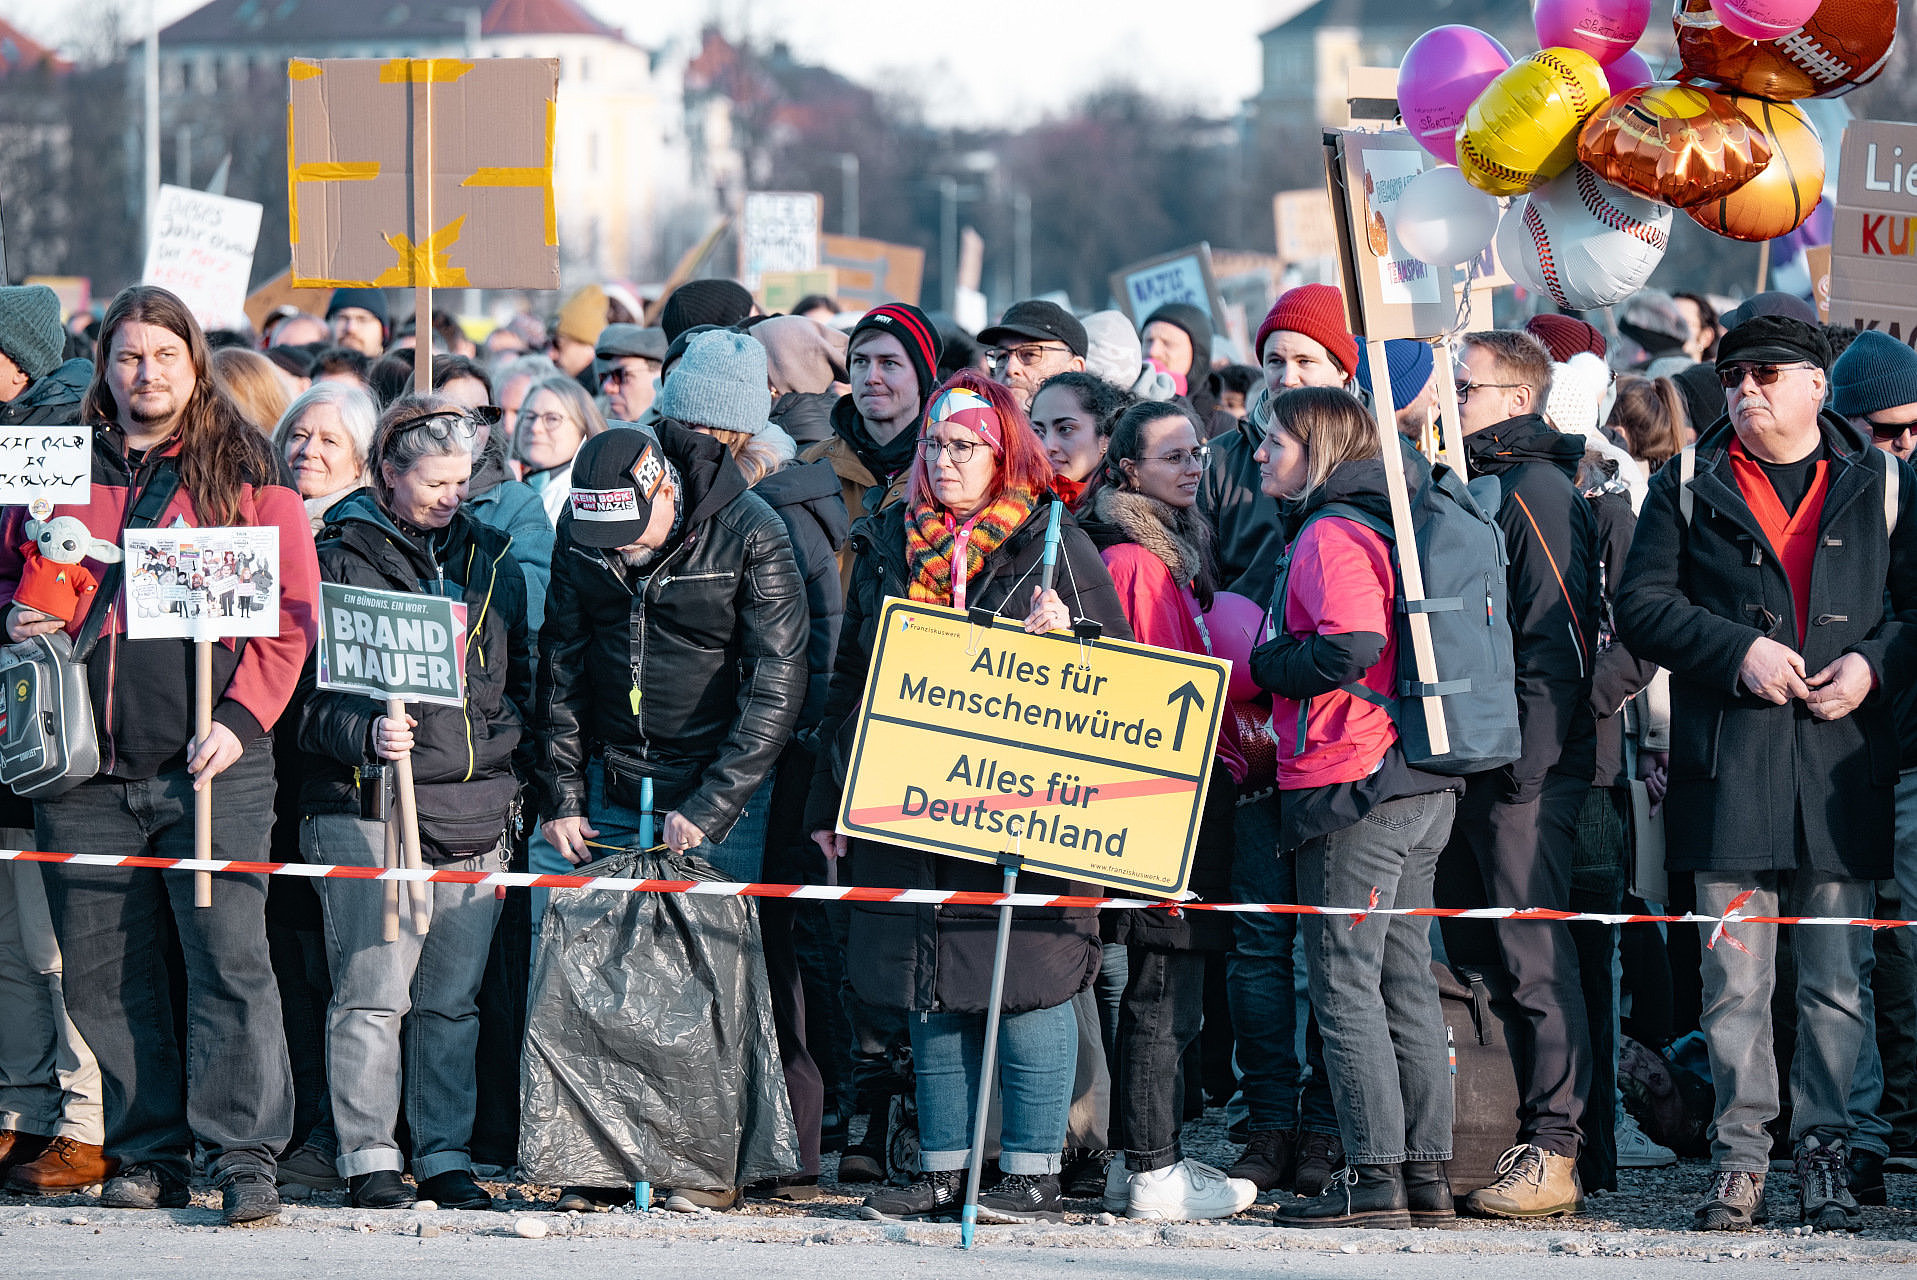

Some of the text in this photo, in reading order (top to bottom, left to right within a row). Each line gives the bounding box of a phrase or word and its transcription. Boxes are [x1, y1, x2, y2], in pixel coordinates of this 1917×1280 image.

[573, 493, 596, 503] KEIN
[597, 501, 633, 512] NAZIS
[343, 594, 429, 614] EIN BÜNDNIS. EIN WORT.
[331, 607, 448, 653] BRAND
[910, 623, 961, 639] Franziskuswerk
[335, 643, 452, 690] MAUER
[970, 647, 1108, 696] Alles für
[899, 672, 1163, 749] Menschenwürde
[946, 754, 1100, 809] Alles für
[901, 785, 1129, 858] Deutschland
[1090, 863, 1172, 884] www.franziskuswerk.de
